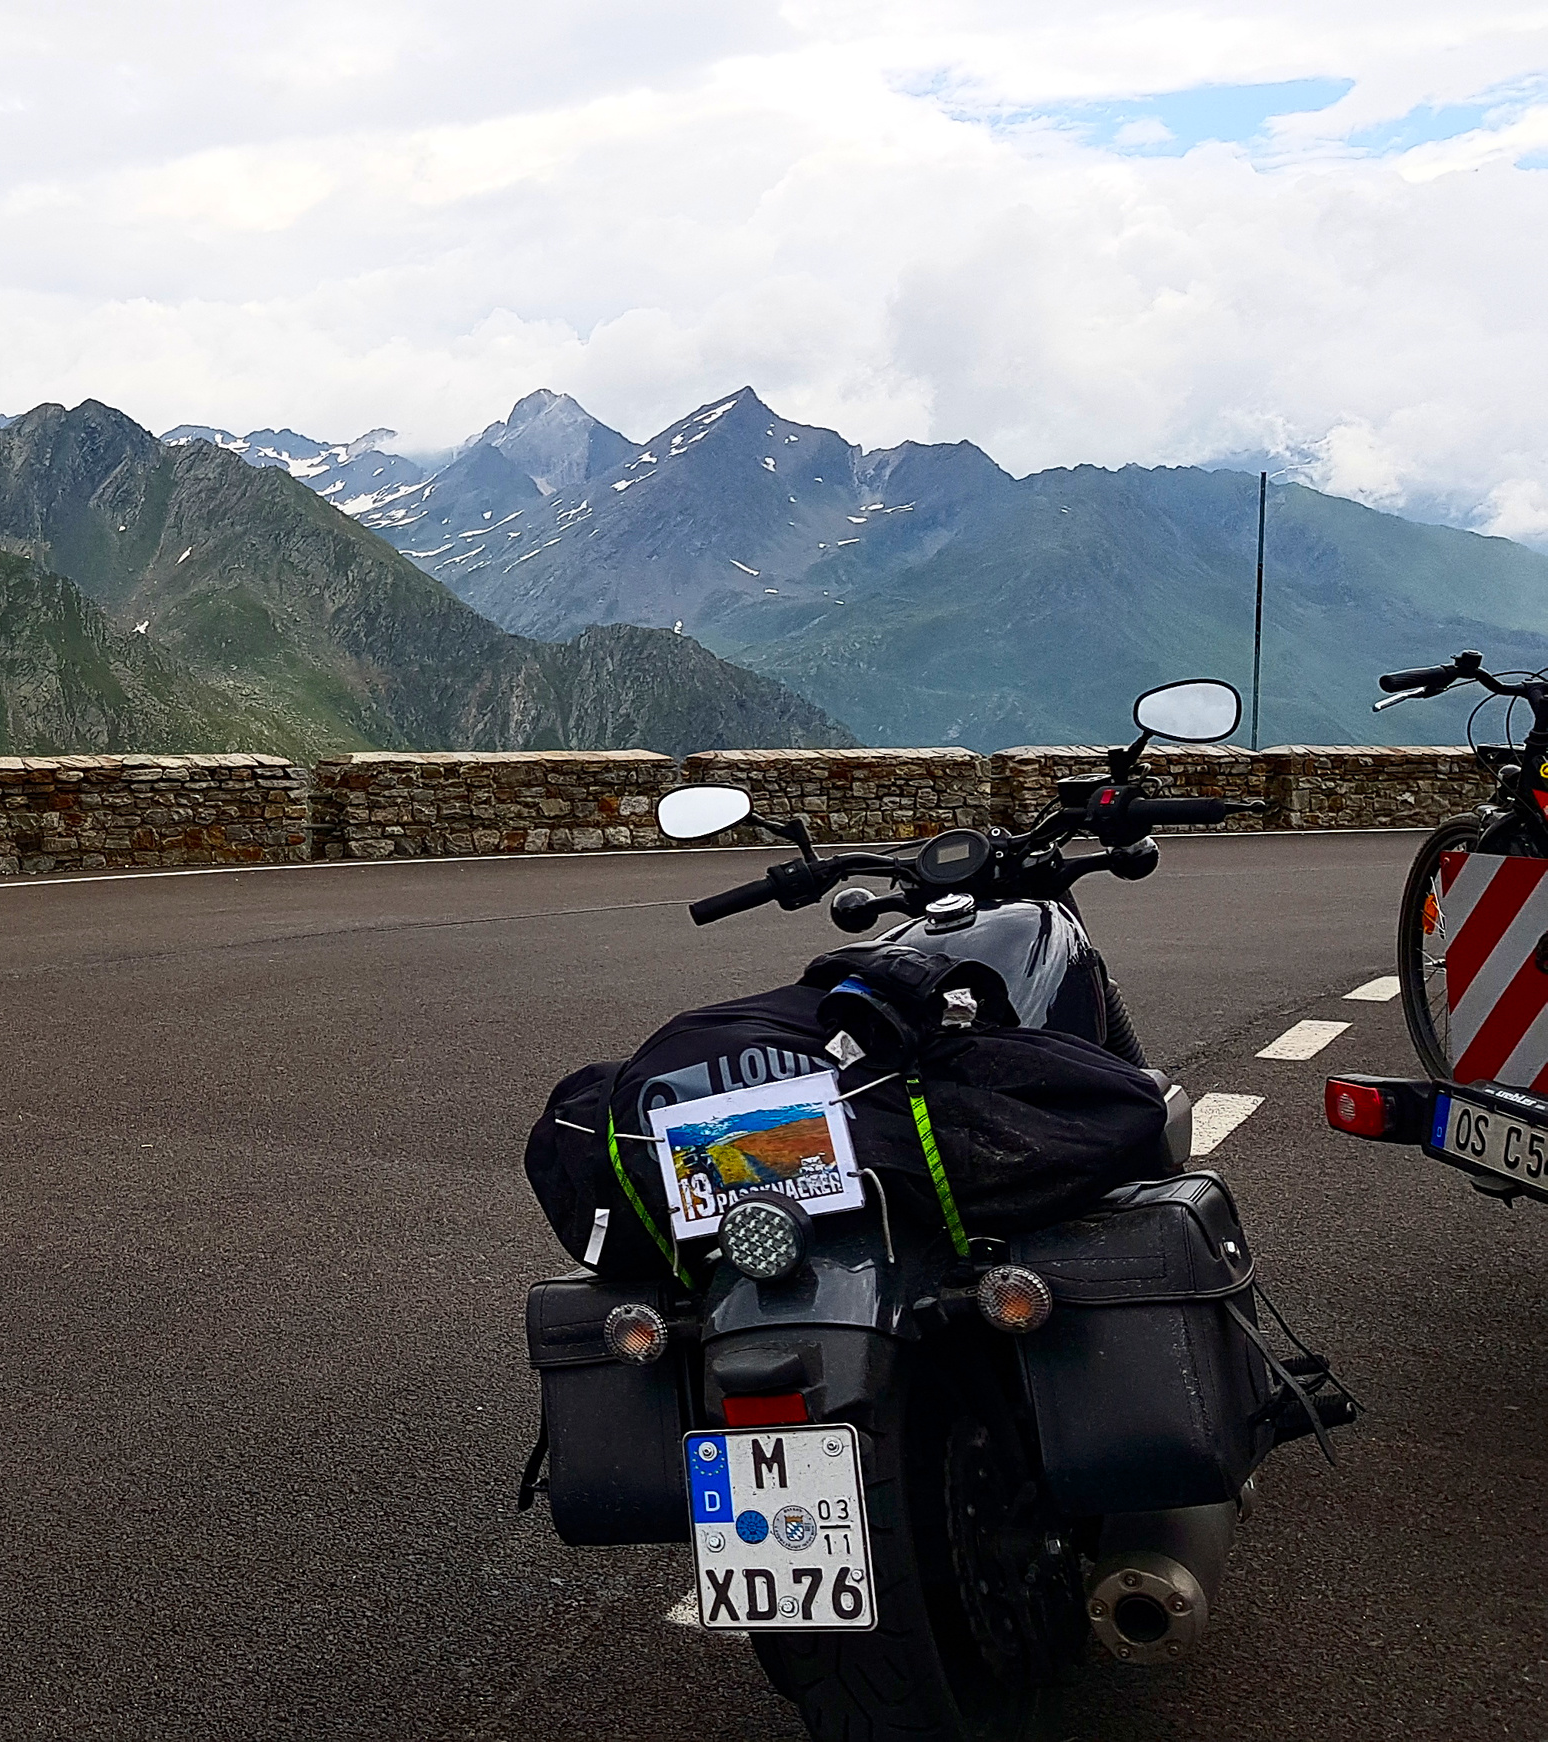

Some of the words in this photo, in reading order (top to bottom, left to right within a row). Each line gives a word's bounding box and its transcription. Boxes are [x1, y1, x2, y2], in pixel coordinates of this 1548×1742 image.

[719, 1047, 834, 1091] LOUI
[1456, 1108, 1489, 1157] OS
[1526, 1132, 1548, 1178] 5
[678, 1173, 716, 1219] 19
[752, 1438, 788, 1489] M
[704, 1491, 721, 1512] D
[818, 1499, 849, 1520] 03
[824, 1534, 851, 1555] 11
